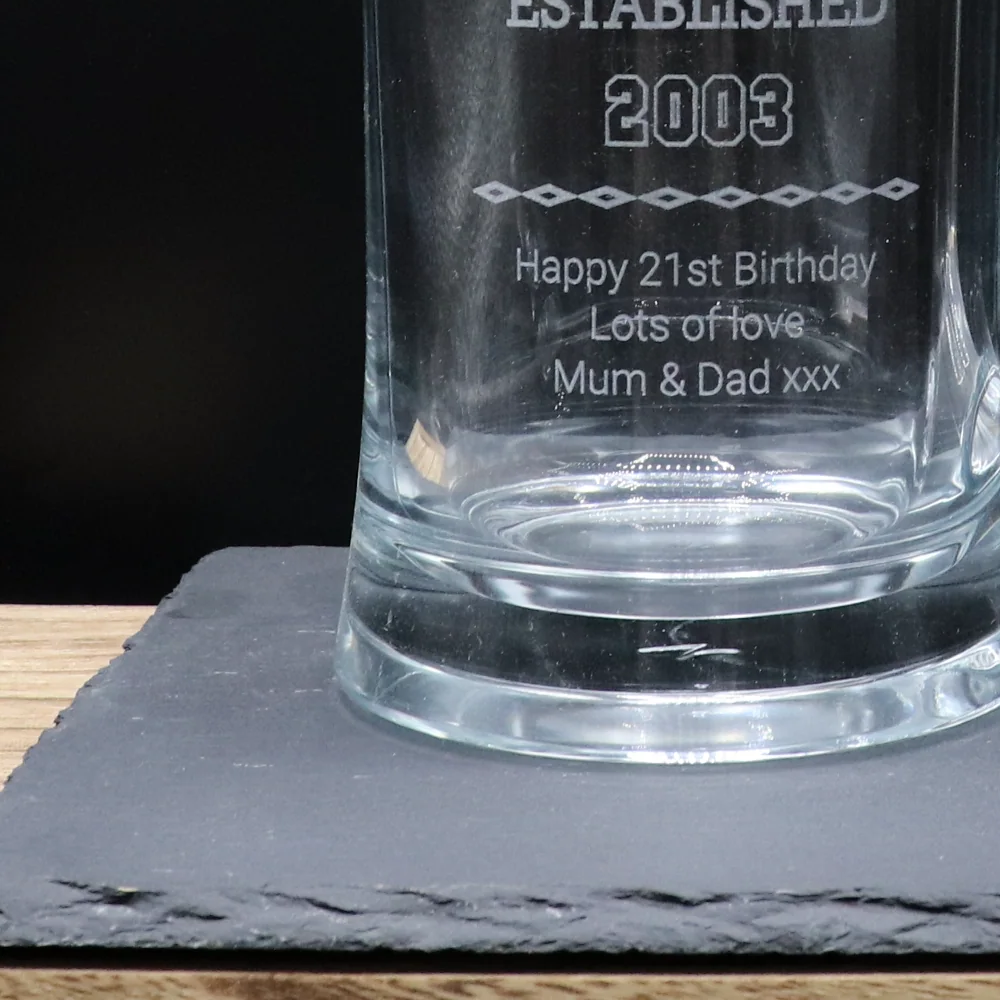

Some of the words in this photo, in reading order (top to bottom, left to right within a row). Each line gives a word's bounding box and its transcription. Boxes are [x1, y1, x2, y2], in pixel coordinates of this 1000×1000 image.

[604, 73, 794, 148] 2003
[516, 247, 629, 295] Happy
[639, 251, 723, 288] 21st
[734, 245, 877, 288] Birthday
[591, 305, 670, 342] Lots
[682, 305, 721, 341] of
[732, 305, 805, 341] love
[554, 358, 647, 396] Mum
[660, 361, 687, 397] &
[698, 357, 770, 396] Dad
[782, 363, 841, 393] xxx
